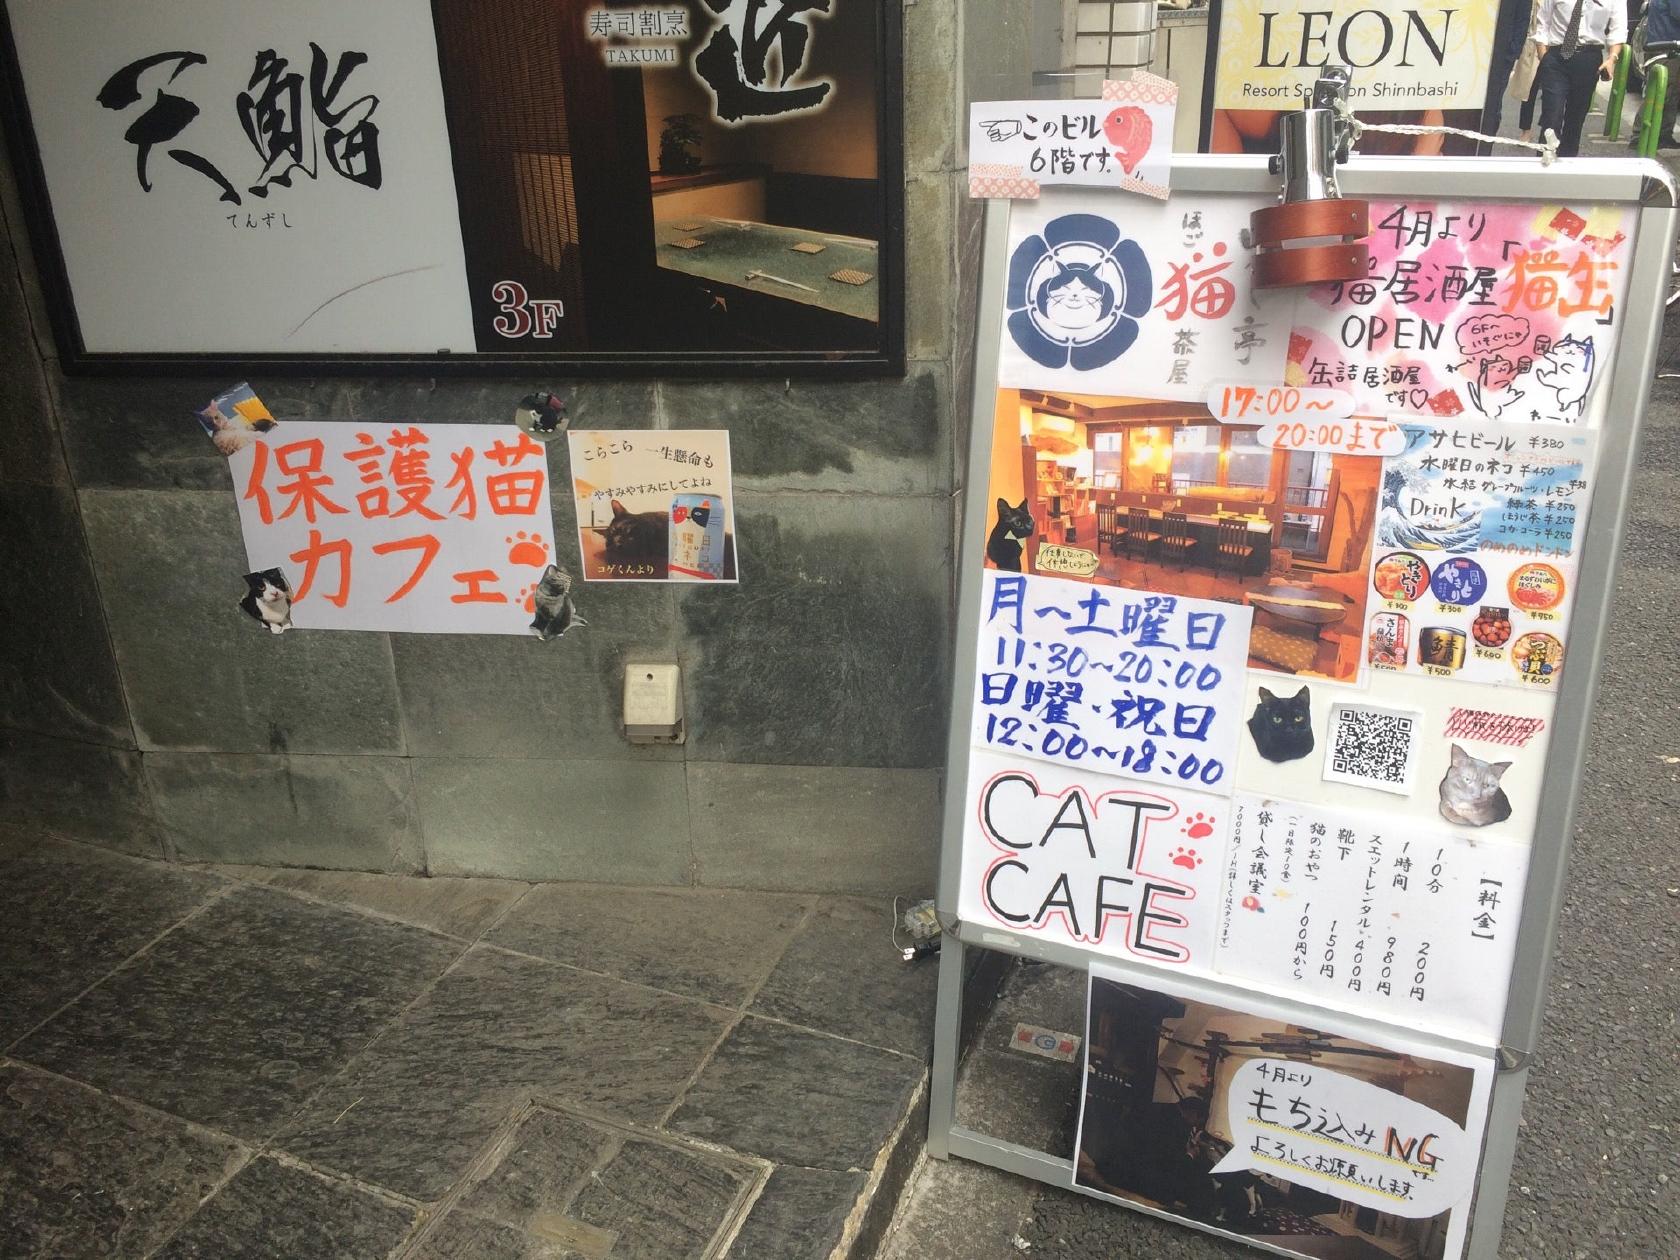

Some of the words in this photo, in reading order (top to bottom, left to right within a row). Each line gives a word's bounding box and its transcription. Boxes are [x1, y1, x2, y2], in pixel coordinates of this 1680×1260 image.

[590, 10, 687, 36] 寿司割烹
[1254, 9, 1460, 68] LEON
[606, 48, 676, 63] TAKUMI
[1243, 83, 1289, 97] Resort
[1372, 81, 1458, 97] Shinnbashi
[96, 42, 382, 206] 天鮨
[1023, 114, 1101, 141] このビル
[1030, 147, 1111, 174] 6階です。
[226, 213, 292, 230] てんずし
[1378, 205, 1486, 248] 4月より
[492, 281, 565, 339] 3F
[1341, 314, 1445, 351] OPEN
[1308, 357, 1421, 388] 缶詰居酒屋
[584, 440, 633, 461] こらこら
[646, 446, 713, 468] 一生懸命も
[1273, 421, 1399, 451] 20:00まで
[1405, 429, 1516, 452] アサヒビール
[1529, 436, 1565, 449] ¥380
[244, 427, 546, 524] 保護猫
[1419, 456, 1513, 475] 水曜日のネコ
[1519, 463, 1555, 478] ¥450
[595, 477, 712, 500] やすみやすみにしてよね
[1411, 497, 1468, 519] Drink
[1507, 497, 1537, 511] 緑茶
[1546, 499, 1576, 511] ¥250
[1544, 514, 1576, 525] ¥250
[1544, 528, 1573, 540] ¥250
[289, 529, 507, 608] カフェ
[598, 564, 654, 575] コゲくんより
[1522, 674, 1551, 685] ¥600
[981, 672, 1216, 742] 日曜・祝日
[984, 774, 1171, 870] CAT
[1249, 811, 1273, 895] 貸し会議室
[1304, 822, 1327, 881] 猫のおやつ
[1336, 828, 1355, 861] 靴下
[1357, 834, 1383, 928] スエットレンタル
[1392, 841, 1414, 891] 1時間
[1426, 848, 1444, 894] 10分
[986, 859, 1186, 958] CAFE
[1471, 878, 1503, 940] 【料金】
[1293, 903, 1311, 980] 100円から
[1319, 920, 1337, 978] 150円
[1347, 940, 1364, 992] 400円
[1376, 937, 1396, 996] 980円
[1410, 942, 1430, 1001] 200円
[1256, 1063, 1312, 1087] 4月より
[1248, 1087, 1376, 1145] もち込み
[1384, 1125, 1444, 1172] NG
